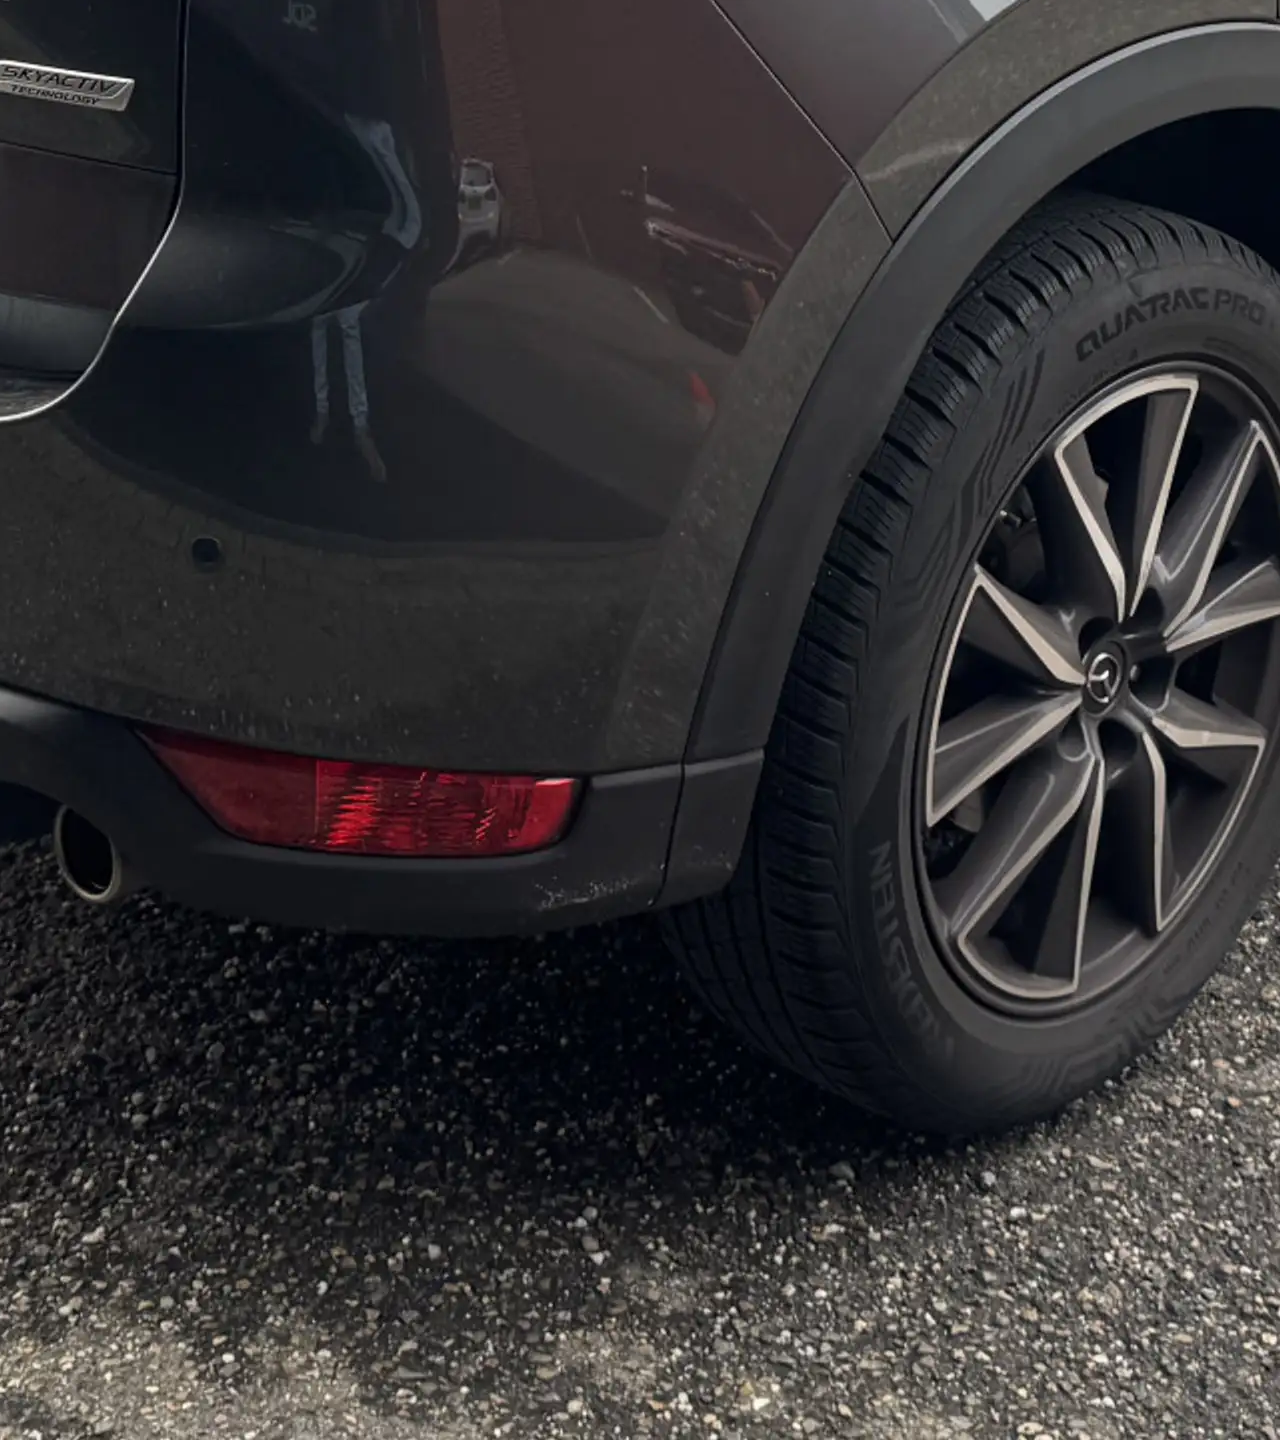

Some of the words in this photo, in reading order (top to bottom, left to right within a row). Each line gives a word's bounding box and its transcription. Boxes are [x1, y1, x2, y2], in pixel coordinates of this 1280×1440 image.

[1, 66, 118, 93] SKYACTIV
[10, 84, 101, 106] TECHNOLOGY
[1075, 286, 1210, 362] QUATRAC
[1214, 288, 1266, 326] PRO
